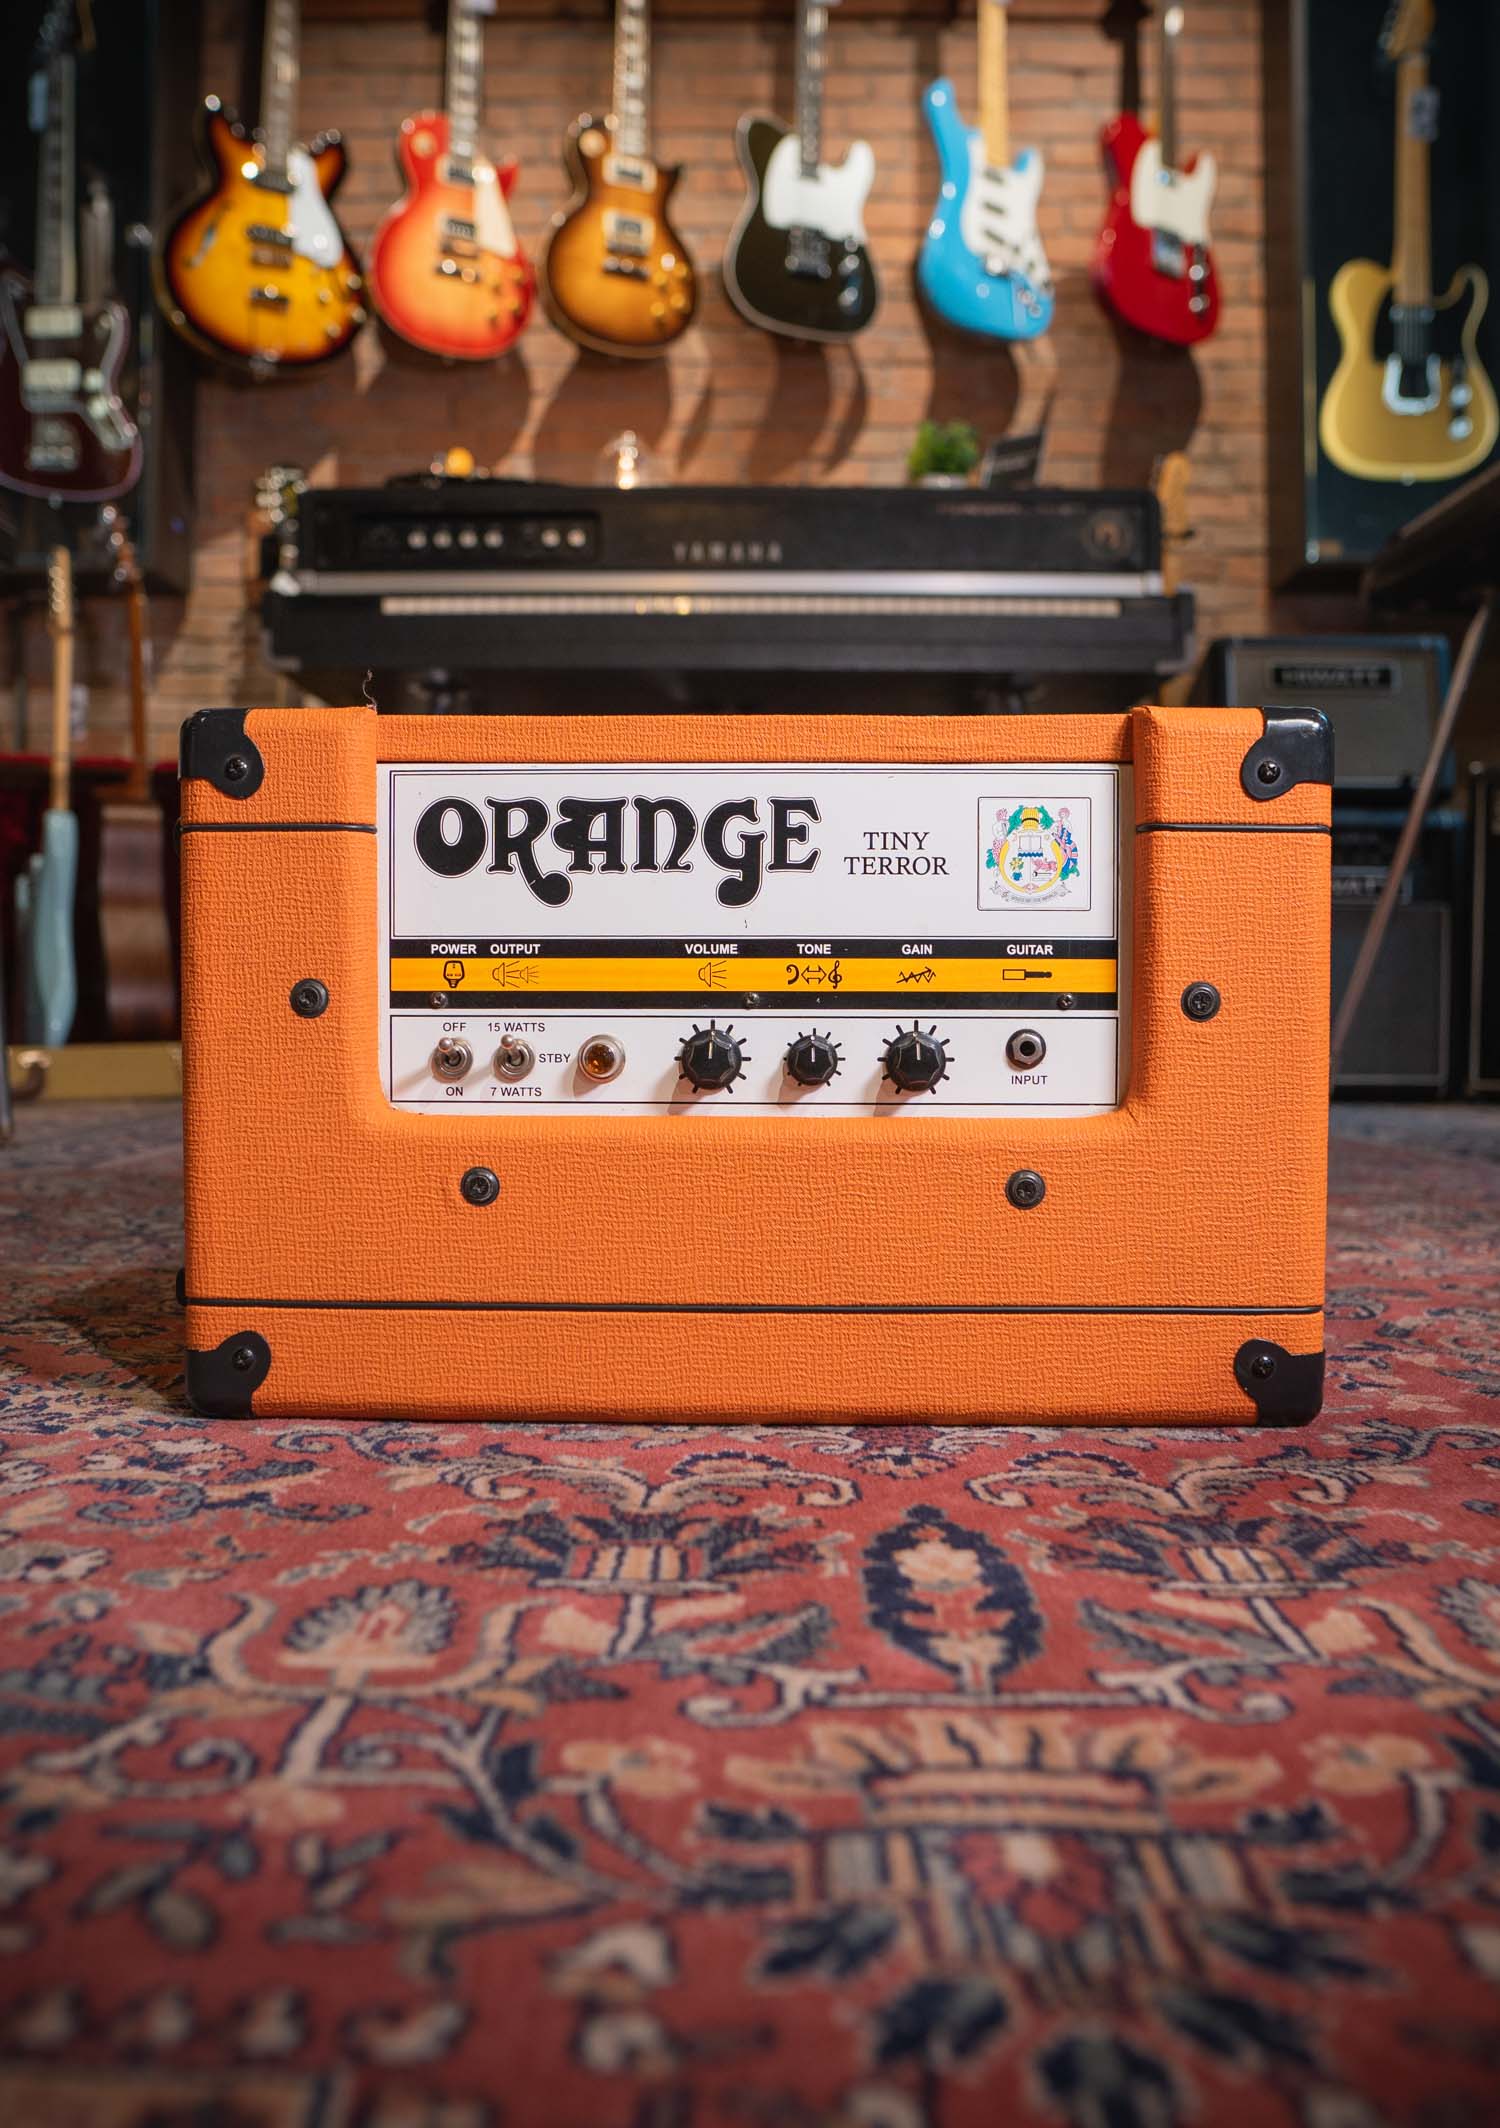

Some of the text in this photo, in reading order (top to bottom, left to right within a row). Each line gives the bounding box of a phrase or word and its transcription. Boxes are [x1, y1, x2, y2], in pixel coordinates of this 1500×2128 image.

[864, 832, 930, 851] TINY
[413, 795, 822, 909] ORANGE
[843, 856, 949, 876] TERROR
[430, 943, 477, 955] POWER
[489, 943, 541, 955] OUTPUT
[684, 943, 739, 955] VOLUME
[796, 943, 832, 955] TONE
[901, 943, 933, 955] GAIN
[1006, 944, 1054, 956] GUITAR
[442, 1022, 467, 1032] OFF
[487, 1022, 546, 1033] 15 WATTS
[538, 1053, 571, 1063] STBY
[1011, 1074, 1048, 1085] INPUT
[445, 1086, 464, 1097] ON
[490, 1086, 542, 1097] 7 WATTS
